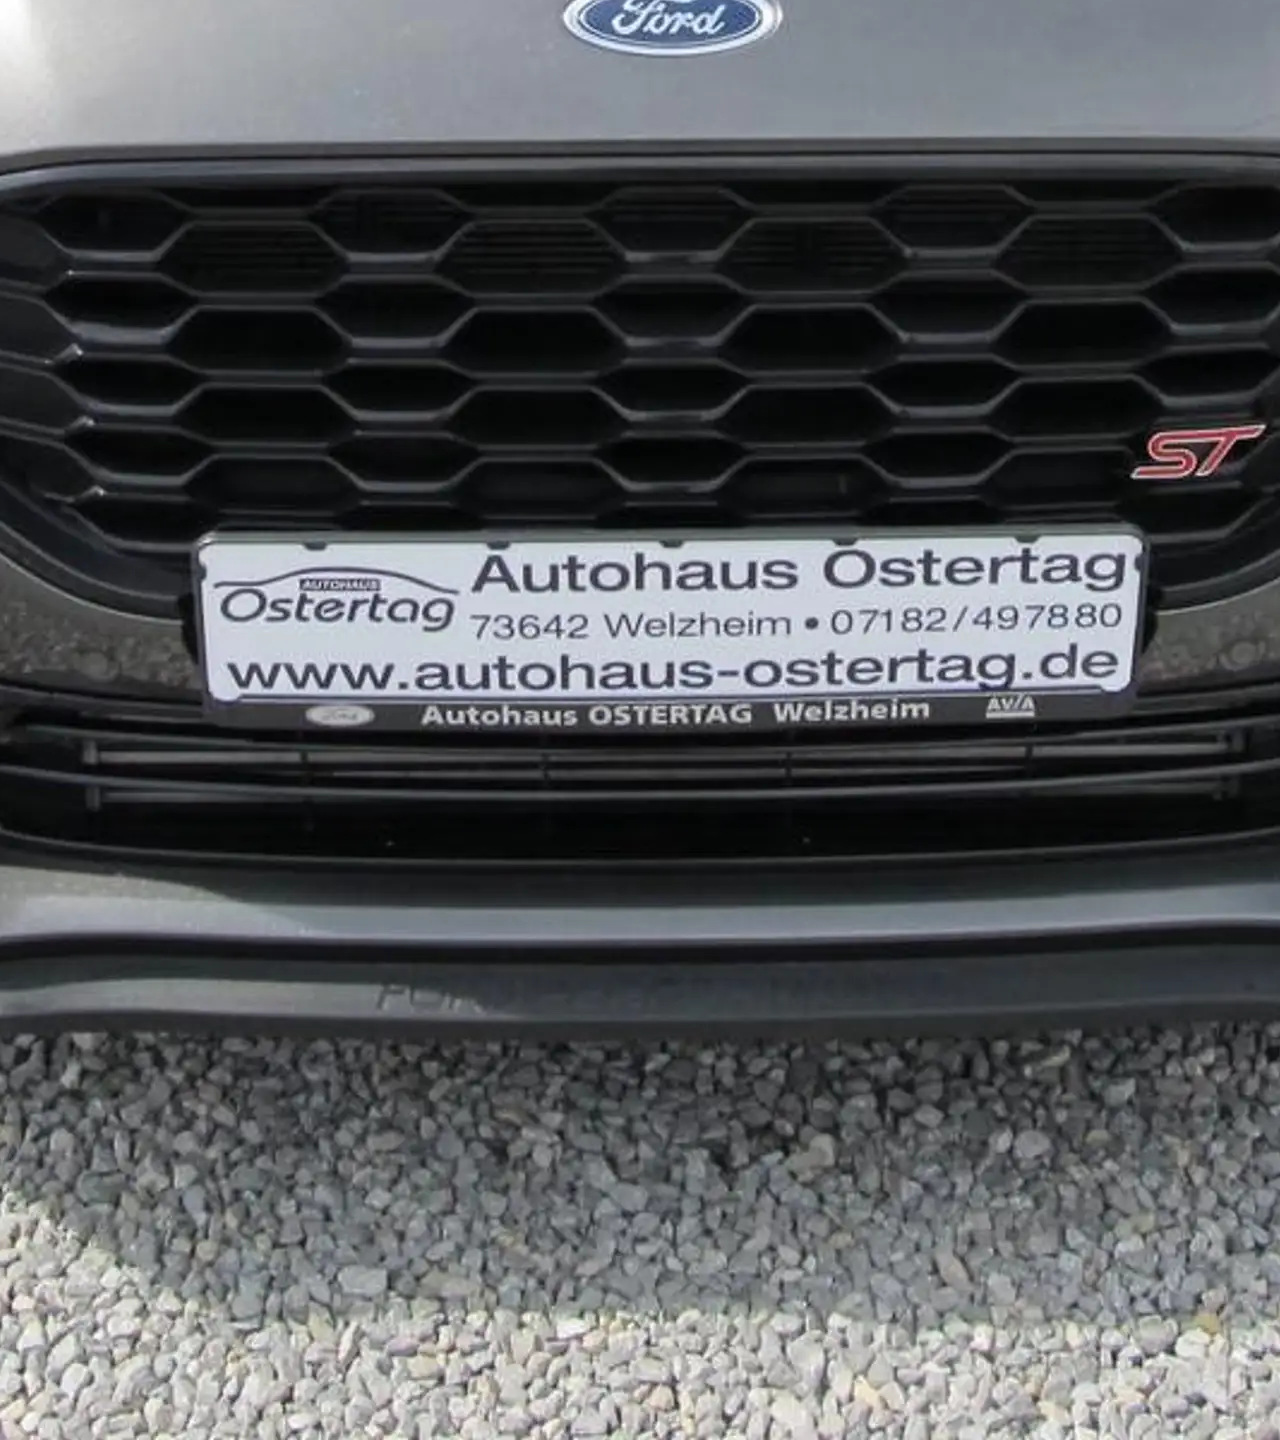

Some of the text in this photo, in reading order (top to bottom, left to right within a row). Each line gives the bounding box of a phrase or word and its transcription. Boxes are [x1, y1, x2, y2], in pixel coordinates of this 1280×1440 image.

[1130, 424, 1267, 479] ST
[471, 548, 1127, 593] Autohaus Ostertag
[221, 588, 454, 632] Ostertag
[471, 604, 1123, 640] 73642 Welzheim 07182/497880
[227, 643, 1119, 691] www.autohaus-ostertag.de
[421, 698, 930, 726] Autohaus OSTERTAG Welzheim
